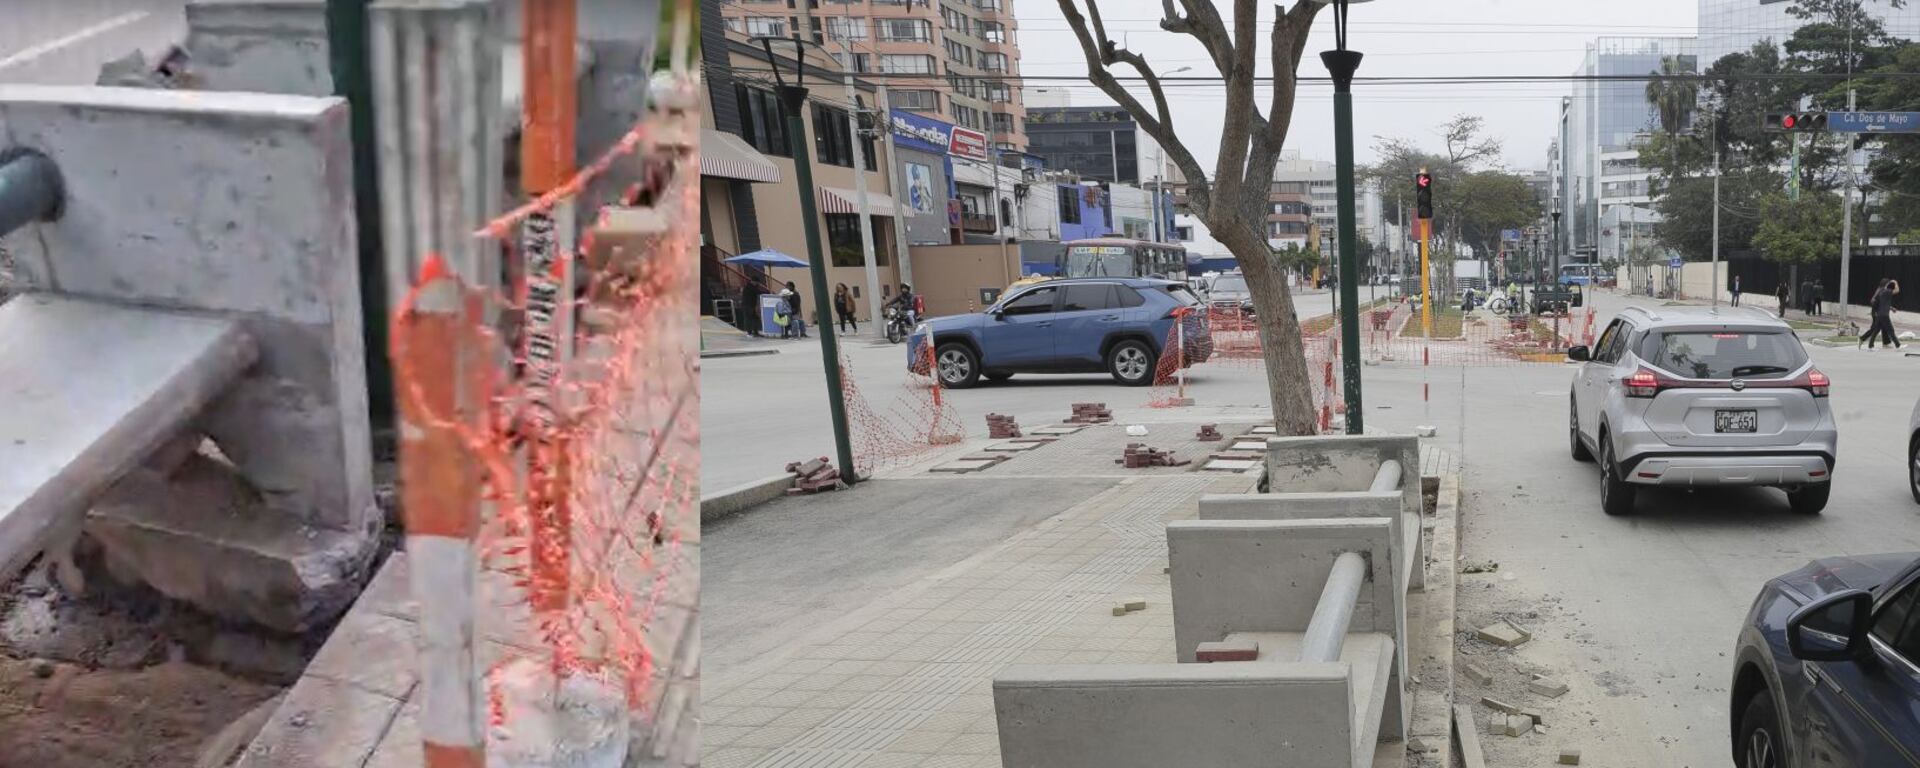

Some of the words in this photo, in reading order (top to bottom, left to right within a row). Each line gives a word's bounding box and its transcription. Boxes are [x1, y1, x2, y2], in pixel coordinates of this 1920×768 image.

[1859, 113, 1874, 122] Dos
[1876, 114, 1885, 122] de
[1889, 114, 1907, 124] Mayo
